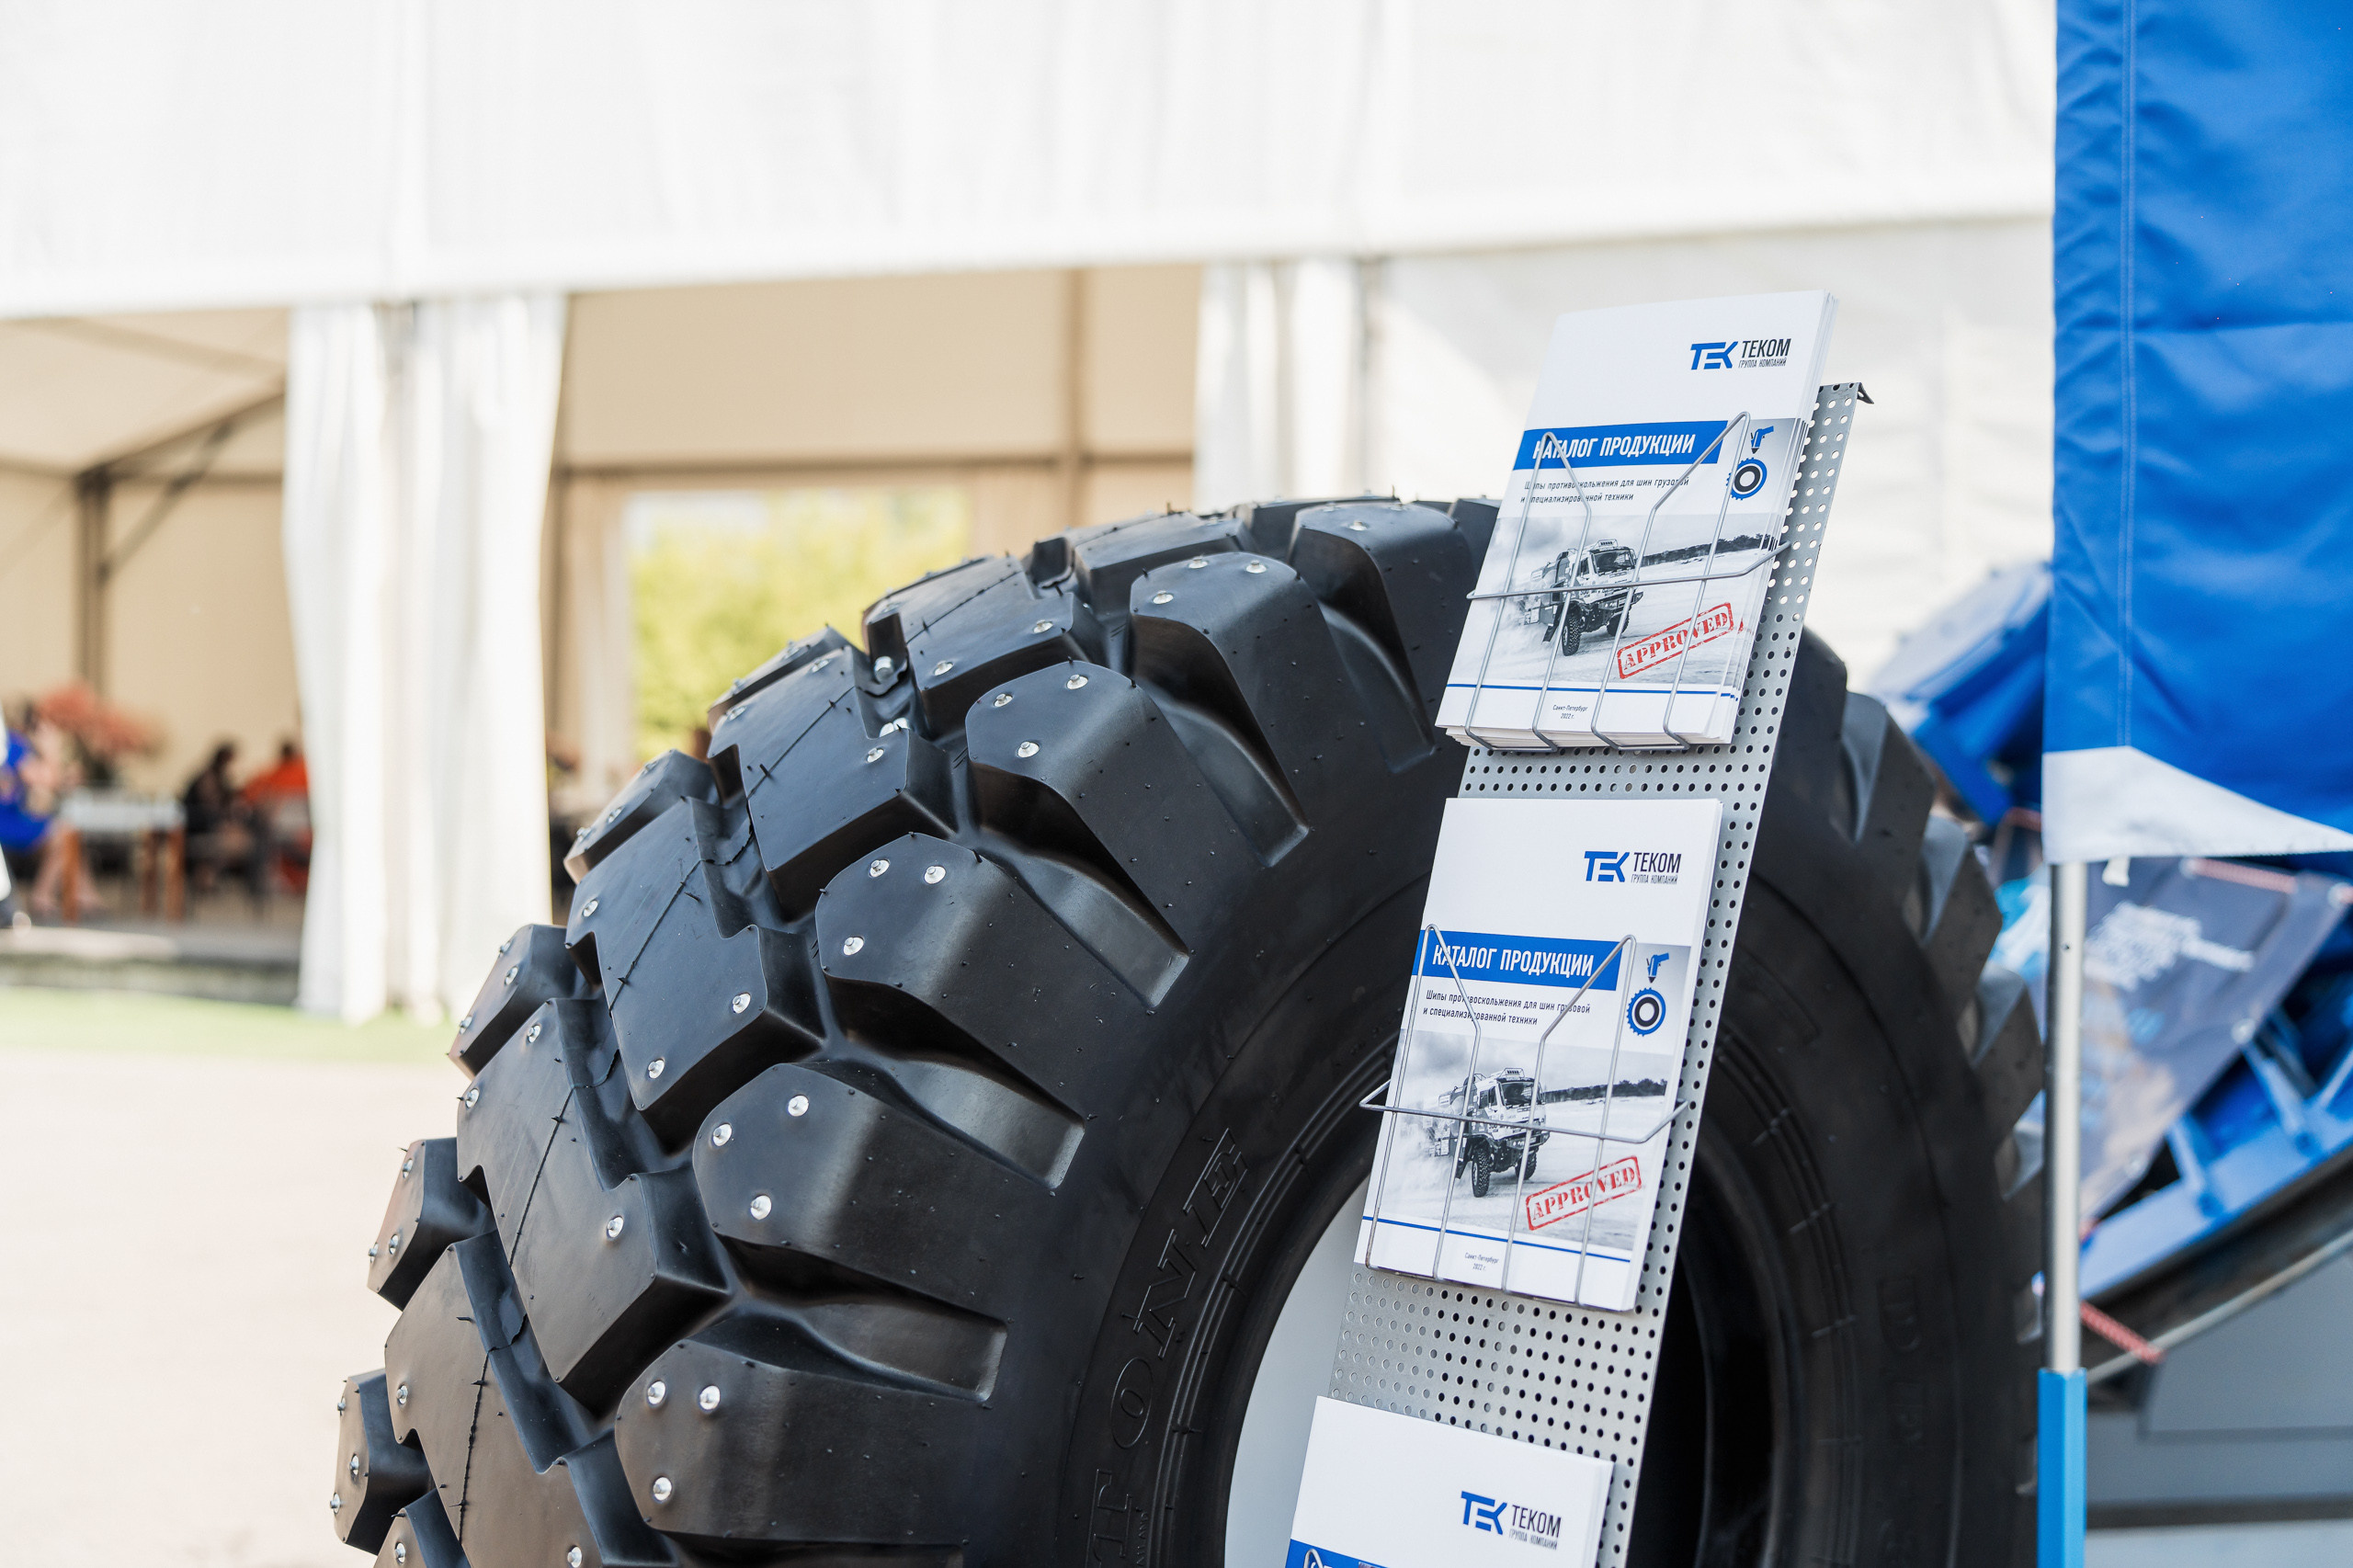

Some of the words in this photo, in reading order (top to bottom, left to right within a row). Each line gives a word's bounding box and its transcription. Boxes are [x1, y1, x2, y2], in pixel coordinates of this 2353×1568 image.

[1742, 338, 1791, 358] ТЕКОМ
[1738, 359, 1757, 369] ГРУППА
[1758, 357, 1787, 368] КОМПАНИЙ
[1599, 434, 1696, 458] ПРОДУКЦИИ
[1547, 480, 1620, 492] противокольжения
[1620, 479, 1634, 488] для
[1636, 478, 1653, 486] шин
[1530, 493, 1603, 506] пециализировнной
[1623, 611, 1729, 671] APPROVED
[1633, 852, 1682, 873] ТЕКОМ
[1631, 873, 1649, 883] ГРУППА
[1650, 875, 1678, 884] КОМПАНИЙ
[1432, 945, 1498, 970] КАТАЛОГ
[1499, 949, 1595, 978] ПРОДУКЦИИ
[1426, 990, 1448, 1001] Шипы
[1523, 1002, 1538, 1010] для
[1539, 1002, 1556, 1010] шин
[1508, 1016, 1538, 1025] техники
[1532, 1167, 1636, 1221] APPROVED
[1512, 1505, 1562, 1538] ТЕКОМ
